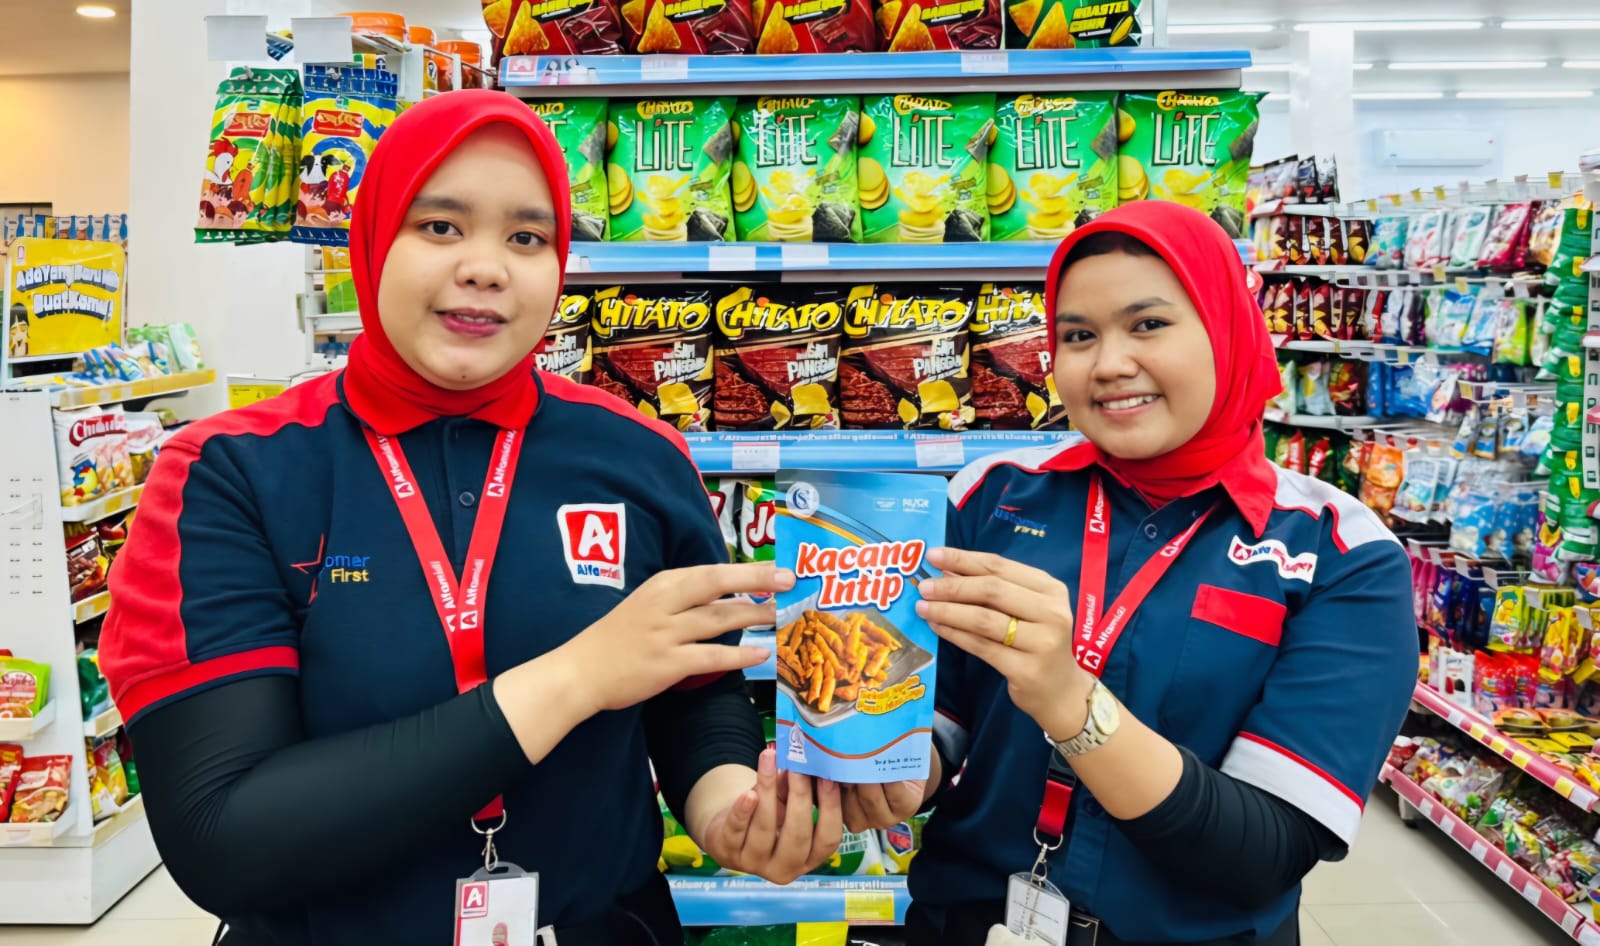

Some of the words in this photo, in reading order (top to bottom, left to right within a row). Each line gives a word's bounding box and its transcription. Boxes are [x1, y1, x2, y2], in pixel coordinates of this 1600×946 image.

[331, 567, 370, 583] First
[796, 539, 925, 576] Kacang
[819, 568, 903, 609] Intip
